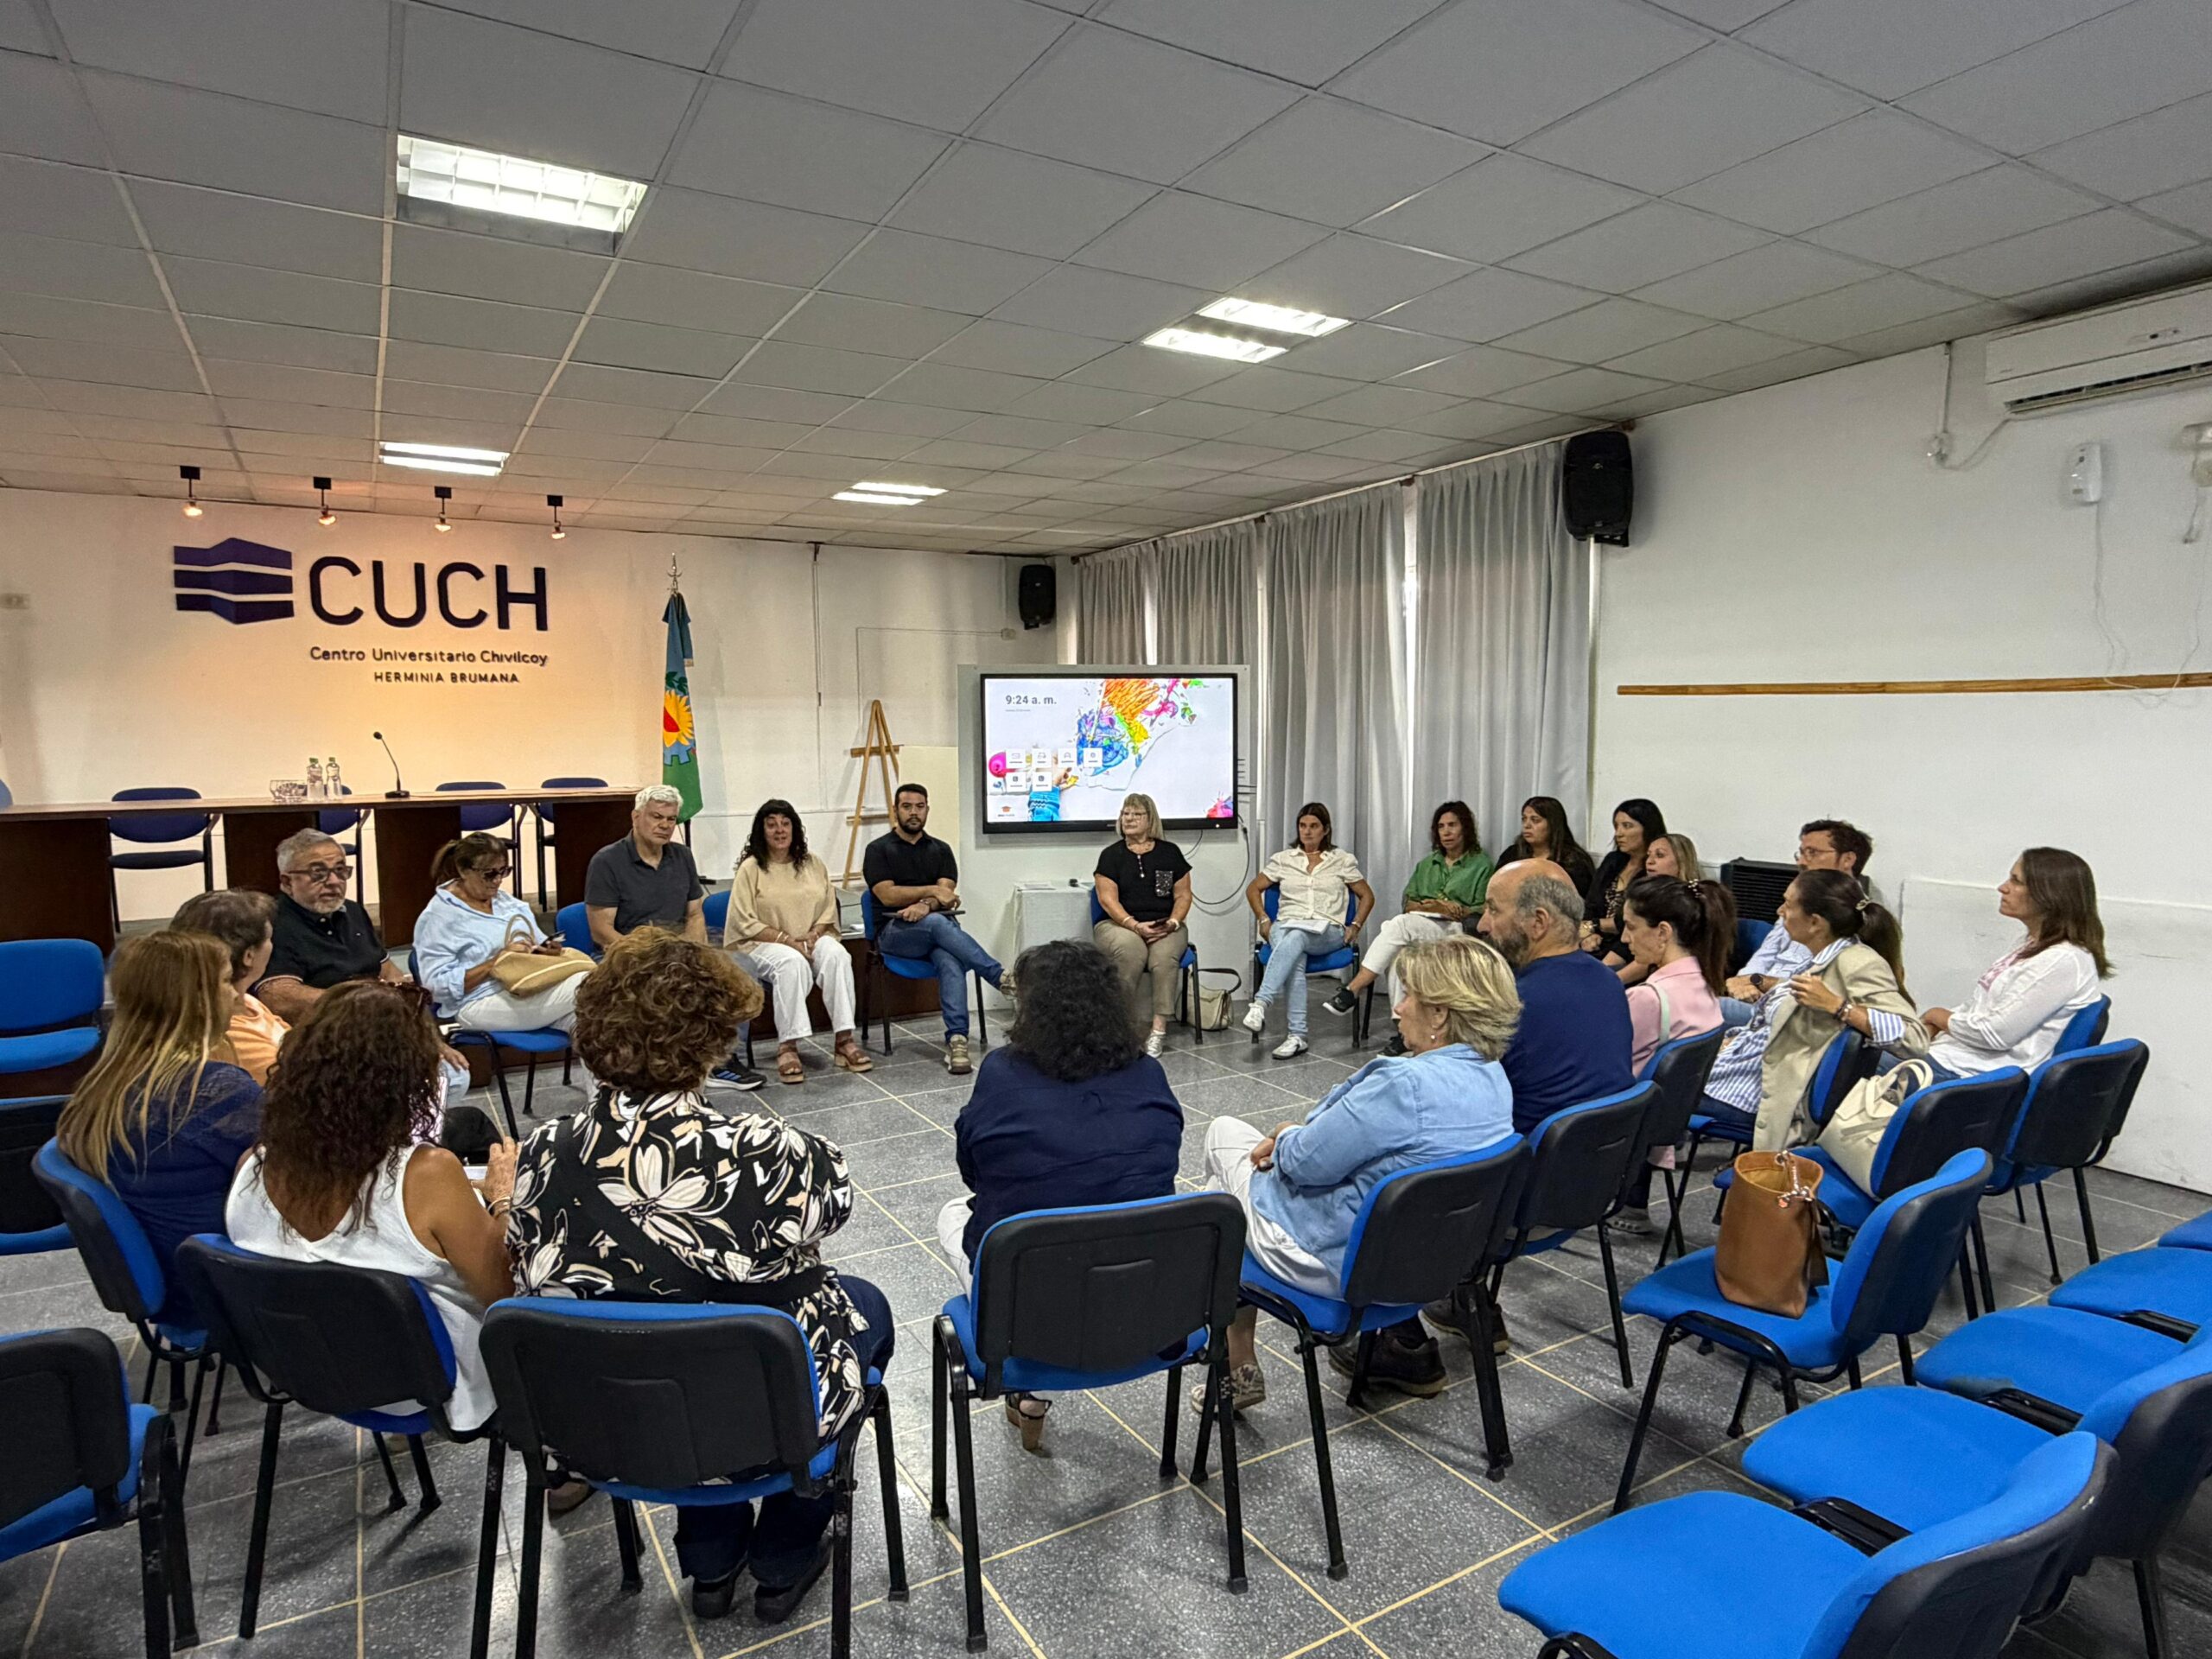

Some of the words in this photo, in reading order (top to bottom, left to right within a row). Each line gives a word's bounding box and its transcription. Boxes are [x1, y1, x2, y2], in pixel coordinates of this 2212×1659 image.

[309, 556, 549, 632] CUCH
[309, 646, 365, 661] Centro
[372, 648, 476, 663] Universitario
[480, 650, 548, 667] Chivilcoy
[373, 671, 444, 683] HERMINIA
[450, 672, 520, 683] BRUMANA
[1005, 695, 1029, 705] 9:24
[1031, 696, 1041, 705] a.
[1043, 696, 1057, 705] m.
